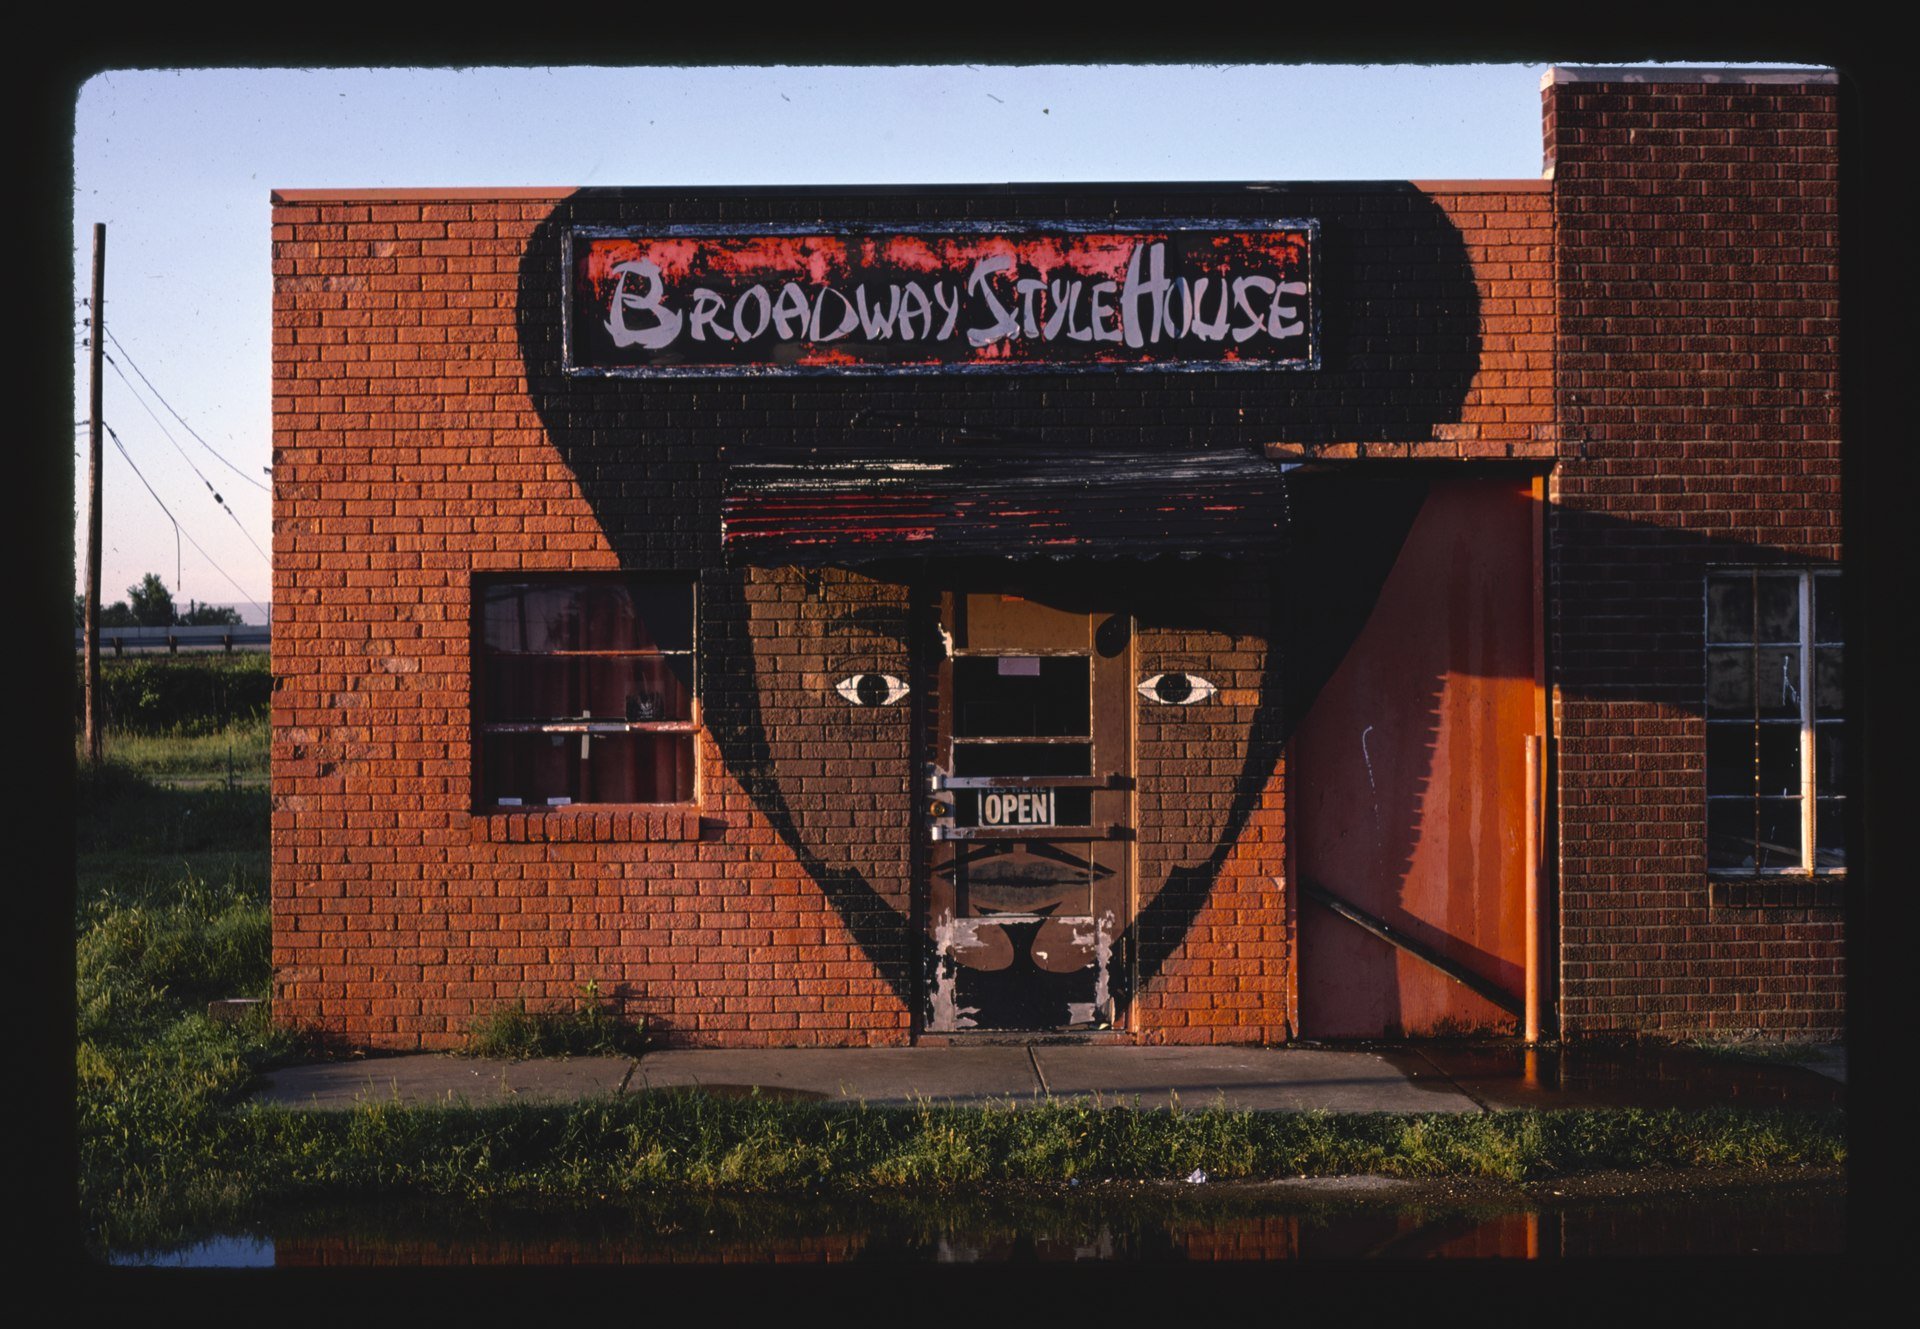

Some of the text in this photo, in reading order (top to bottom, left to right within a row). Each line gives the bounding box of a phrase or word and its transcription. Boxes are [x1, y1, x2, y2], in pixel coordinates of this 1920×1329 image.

[604, 242, 1307, 350] BROADWAY STYLE HOUSE
[1012, 784, 1046, 793] WERE
[985, 794, 1047, 824] OPEN
